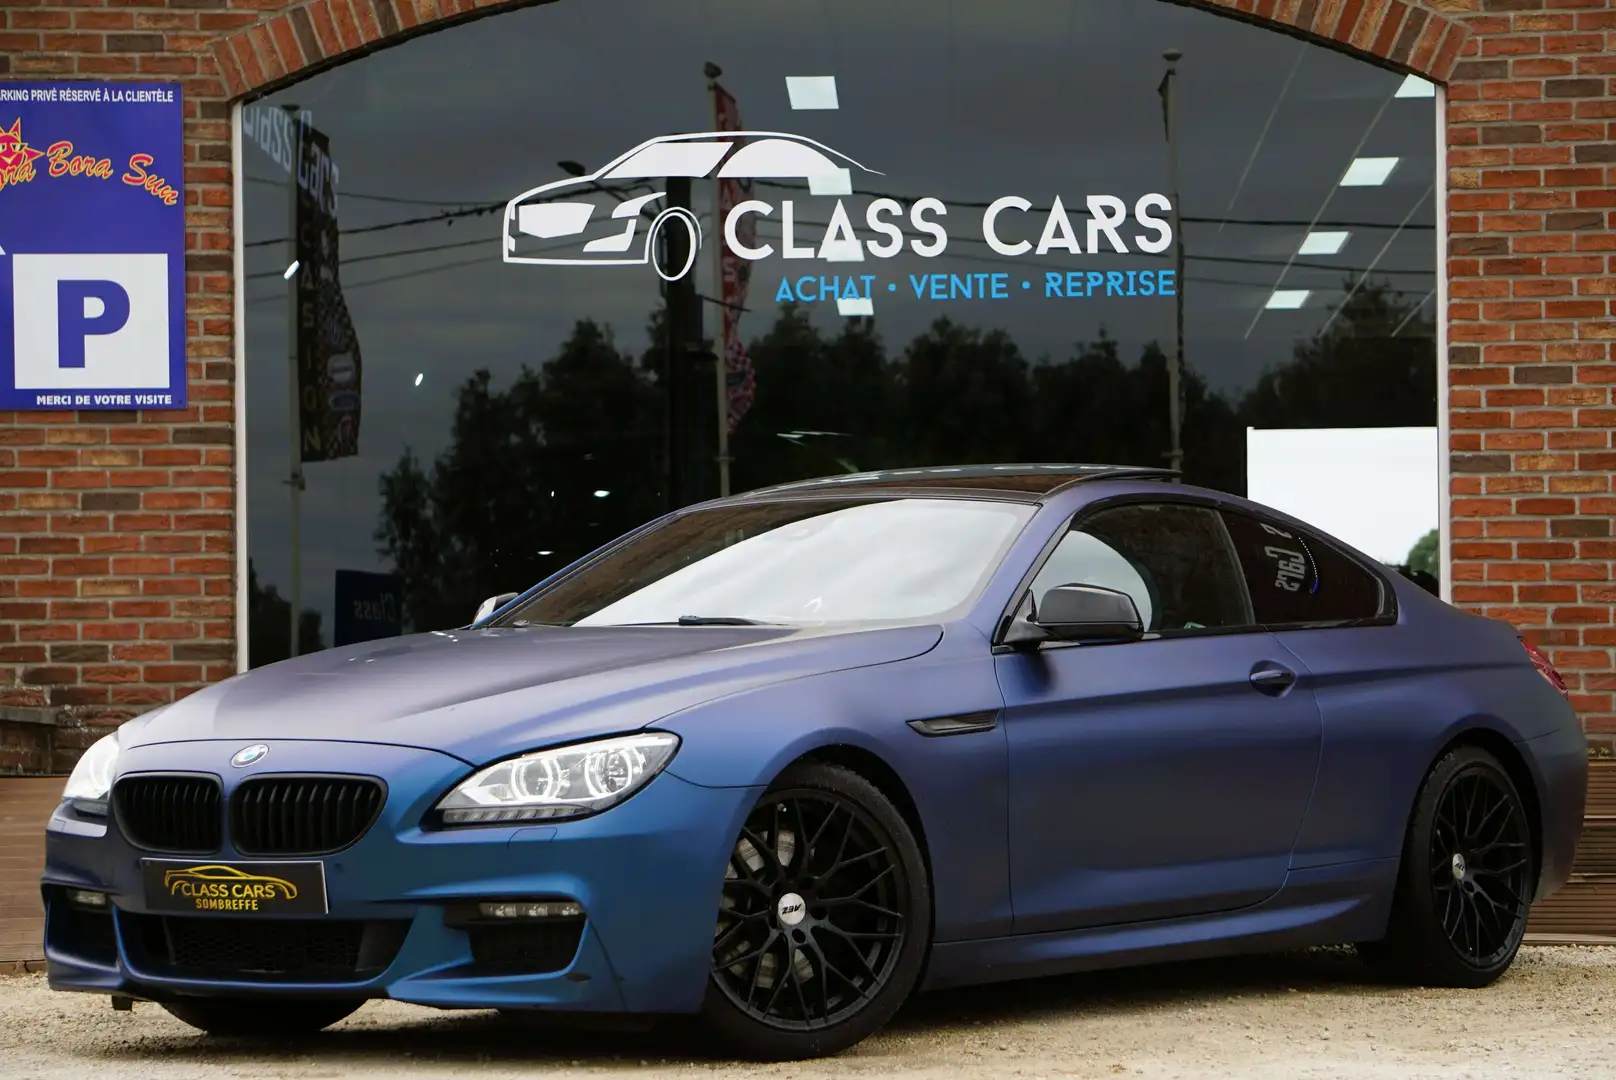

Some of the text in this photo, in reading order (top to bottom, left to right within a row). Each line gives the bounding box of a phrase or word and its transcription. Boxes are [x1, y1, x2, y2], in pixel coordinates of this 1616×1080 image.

[31, 88, 57, 101] PRIVÉ
[60, 88, 101, 102] RÉSERVÉ
[103, 88, 110, 102] À
[112, 91, 124, 102] LA
[46, 141, 113, 179] Bora
[122, 153, 179, 206] Sun
[724, 198, 948, 261] CLASS
[982, 193, 1172, 256] CARS
[775, 270, 1176, 303] ACHAT VENTE REPRISE
[57, 279, 131, 369] P
[36, 394, 172, 406] MERCI DE VOTRE VISITE
[181, 883, 276, 899] CLASS CARS
[195, 898, 259, 911] SOMBREFFE
